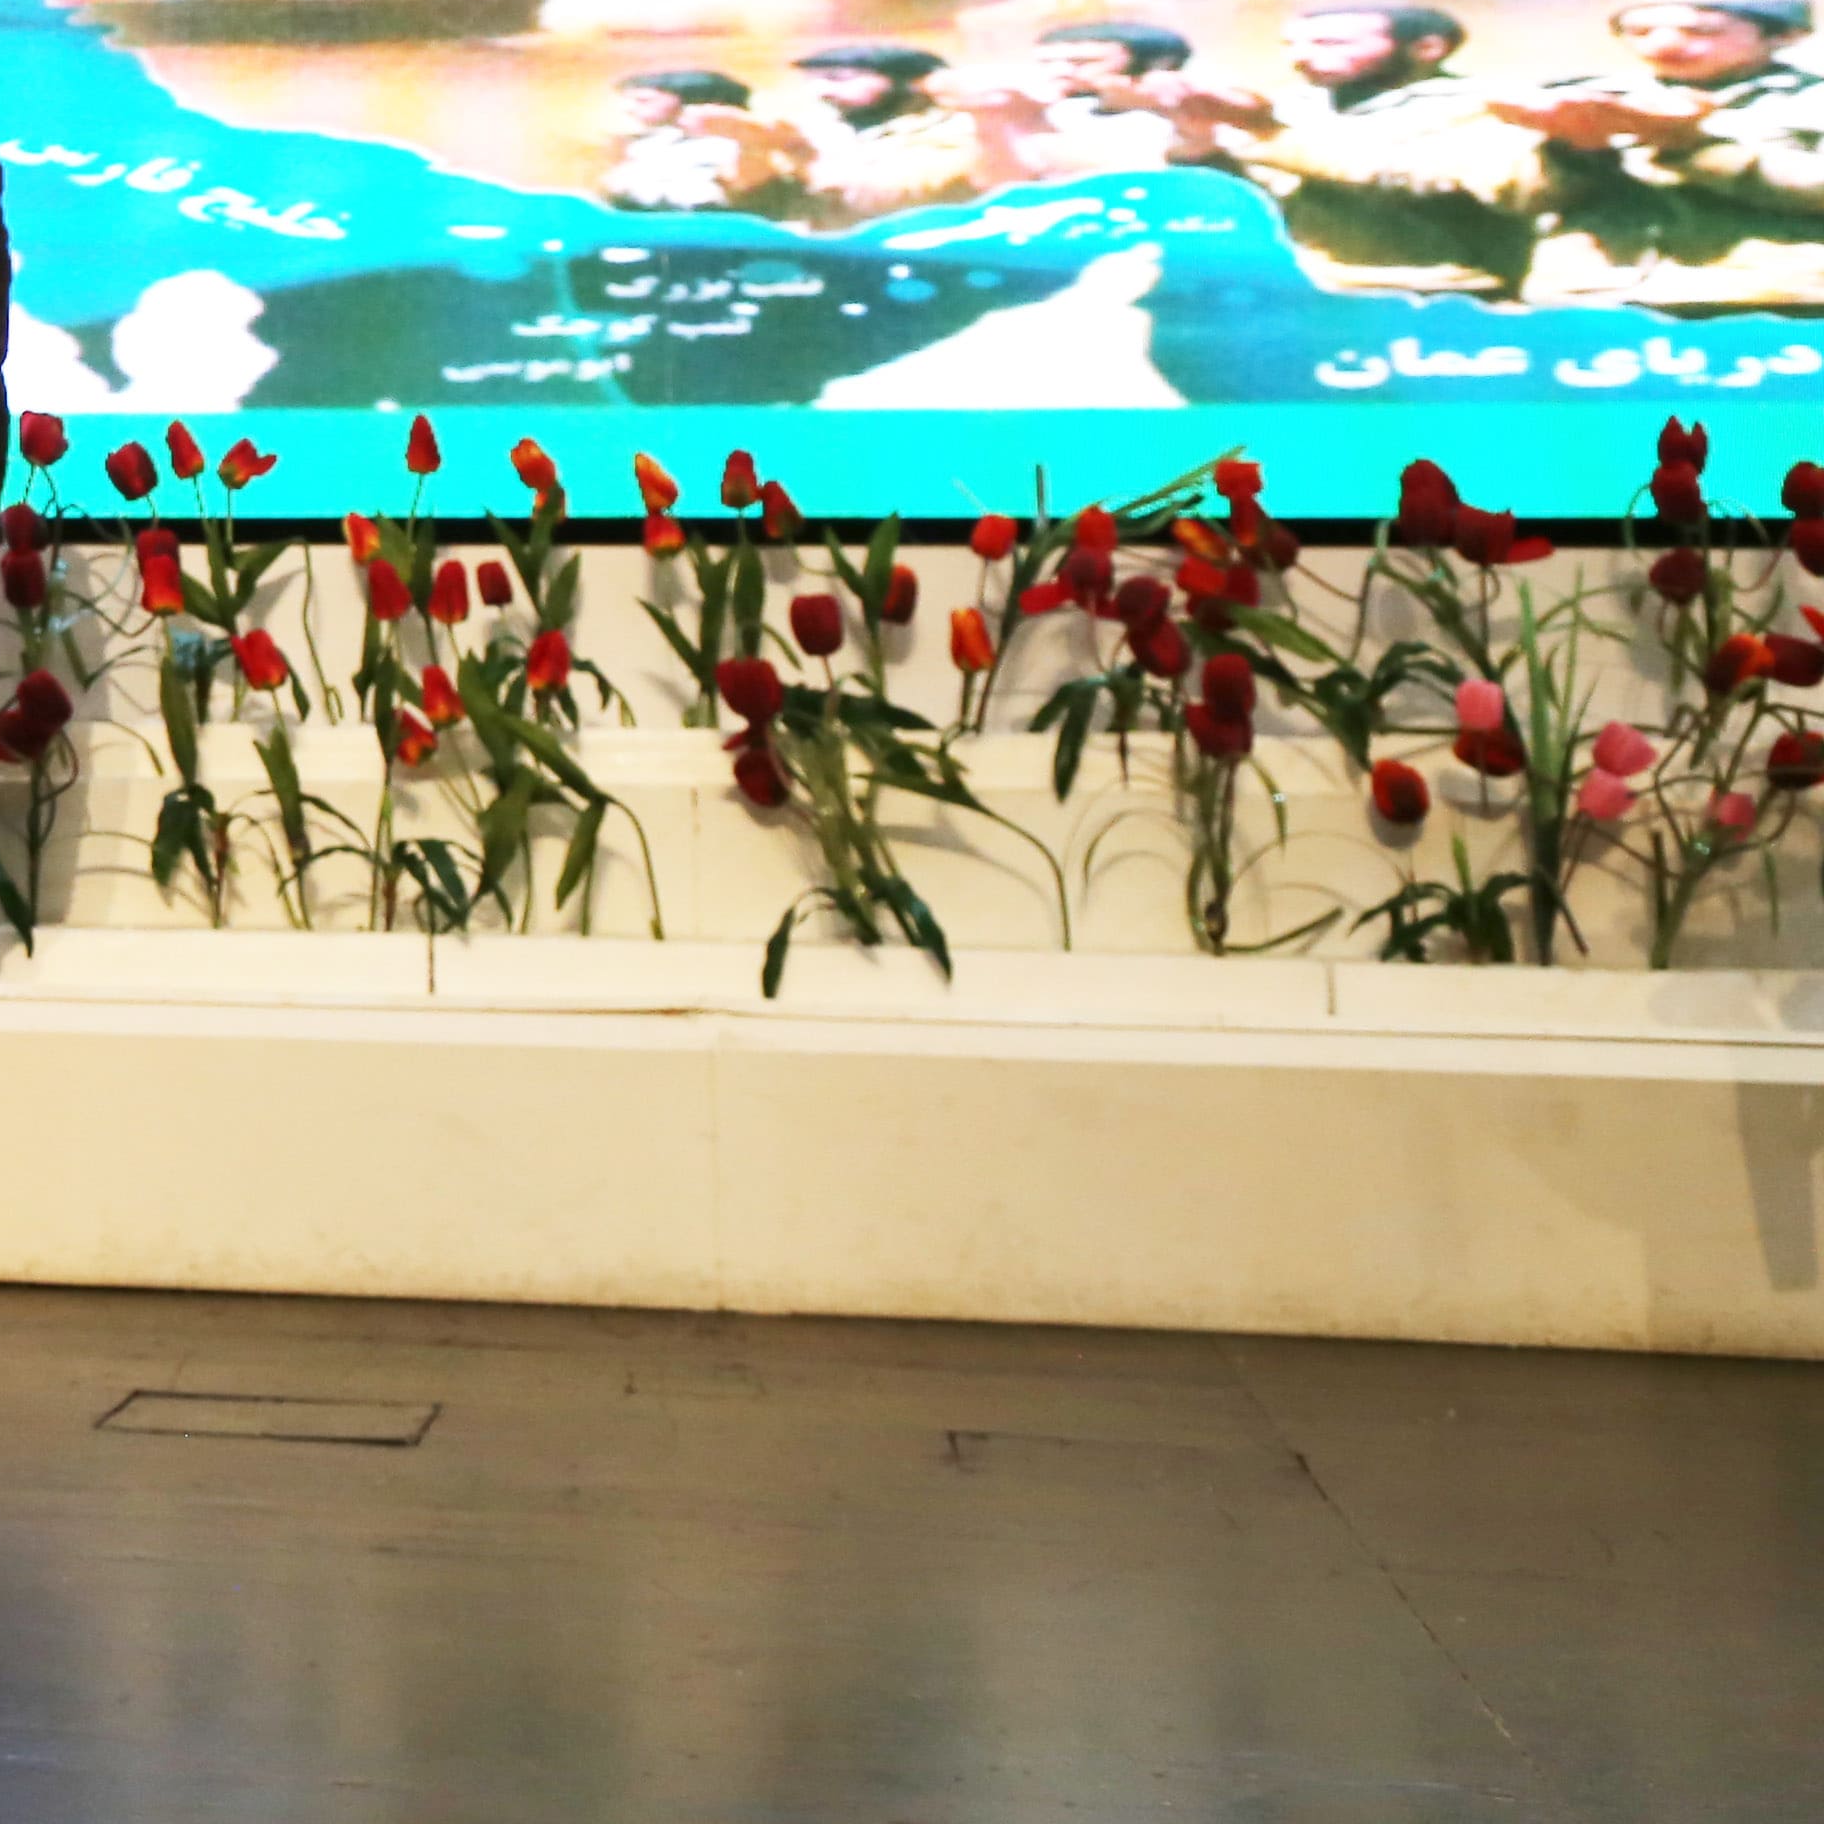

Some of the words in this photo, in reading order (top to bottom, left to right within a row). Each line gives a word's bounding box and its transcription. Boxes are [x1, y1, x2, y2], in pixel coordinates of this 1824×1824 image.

[175, 185, 349, 240] خلیج
[1314, 336, 1529, 389] عمان
[1554, 337, 1823, 388] دریای
